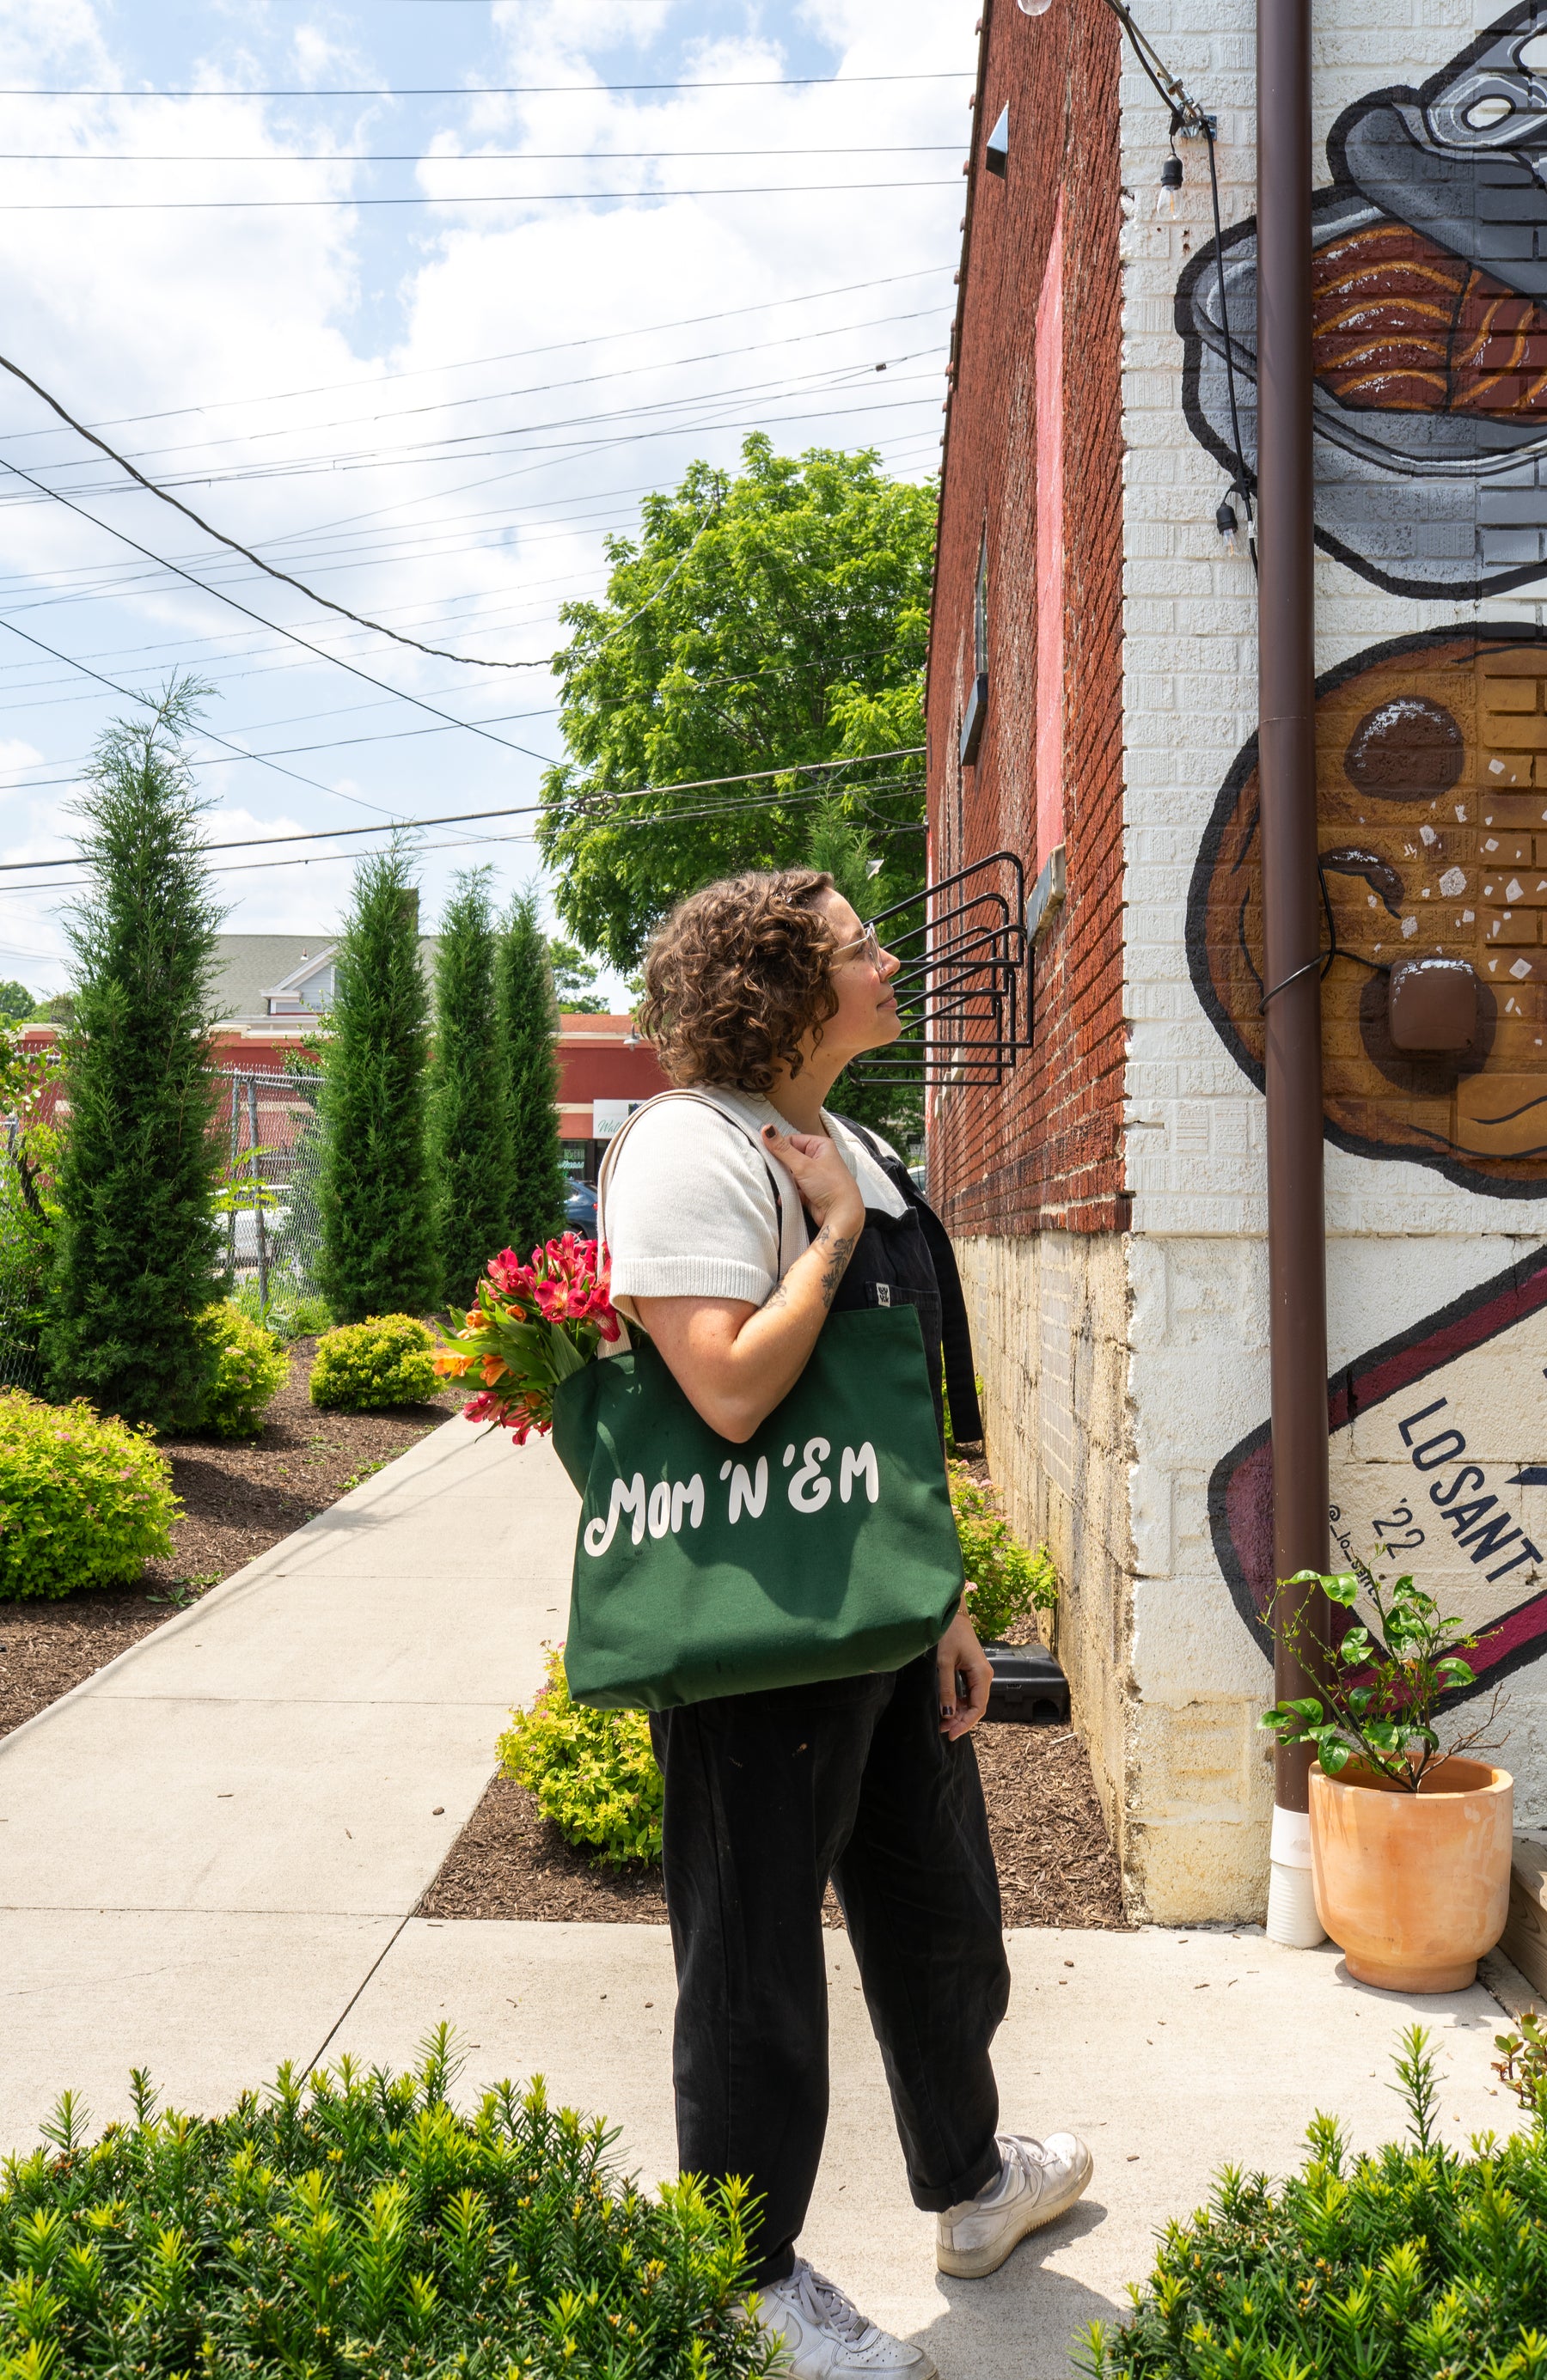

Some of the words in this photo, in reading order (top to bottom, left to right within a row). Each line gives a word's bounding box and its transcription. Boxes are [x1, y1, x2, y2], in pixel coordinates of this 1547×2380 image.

[584, 1472, 705, 1557] MOM
[719, 1455, 768, 1524] 'N
[782, 1437, 879, 1514] 'EM
[1372, 1498, 1425, 1559] '22
[1397, 1396, 1544, 1584] LOSANT
